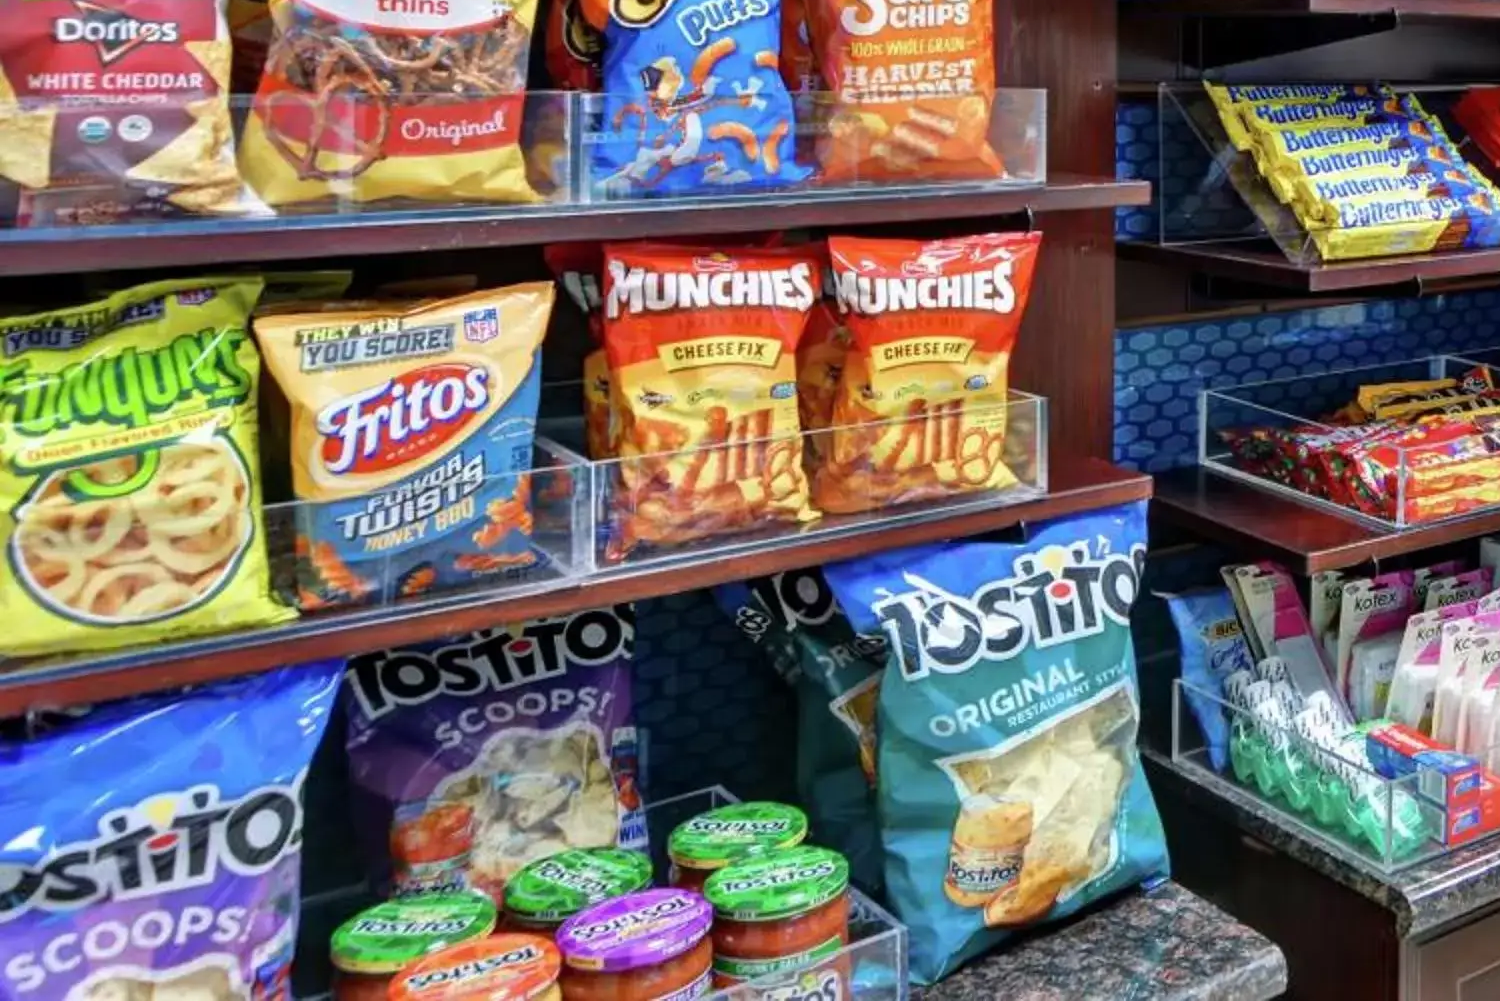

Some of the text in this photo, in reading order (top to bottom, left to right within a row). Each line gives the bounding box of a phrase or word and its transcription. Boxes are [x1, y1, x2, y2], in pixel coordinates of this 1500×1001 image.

[55, 17, 179, 43] Doritos
[889, 3, 971, 29] CHIPS
[27, 72, 204, 91] WHITE CHEDDAR
[843, 58, 977, 85] HARVEST
[1256, 98, 1377, 124] Butterfinger
[400, 111, 509, 149] Original
[1280, 121, 1400, 153] Butterfinger
[1302, 146, 1419, 176] Butterfinger
[1317, 172, 1437, 200] Butterfinger
[606, 259, 815, 319] MUNCHIES
[833, 261, 1016, 315] MUNCHIES
[300, 326, 357, 345] THEY
[306, 326, 455, 366] YOU SCORE!
[673, 341, 767, 362] CHEESE FIX
[883, 342, 940, 362] CHEESE
[316, 366, 490, 474] Fritos
[1354, 590, 1398, 612] Kotex
[1415, 626, 1444, 642] Kot
[929, 657, 1086, 737] ORIGINAL
[1007, 681, 1092, 728] RESTAURANT
[434, 685, 616, 749] SCOOPS!
[4, 905, 257, 994] SCOOPS!
